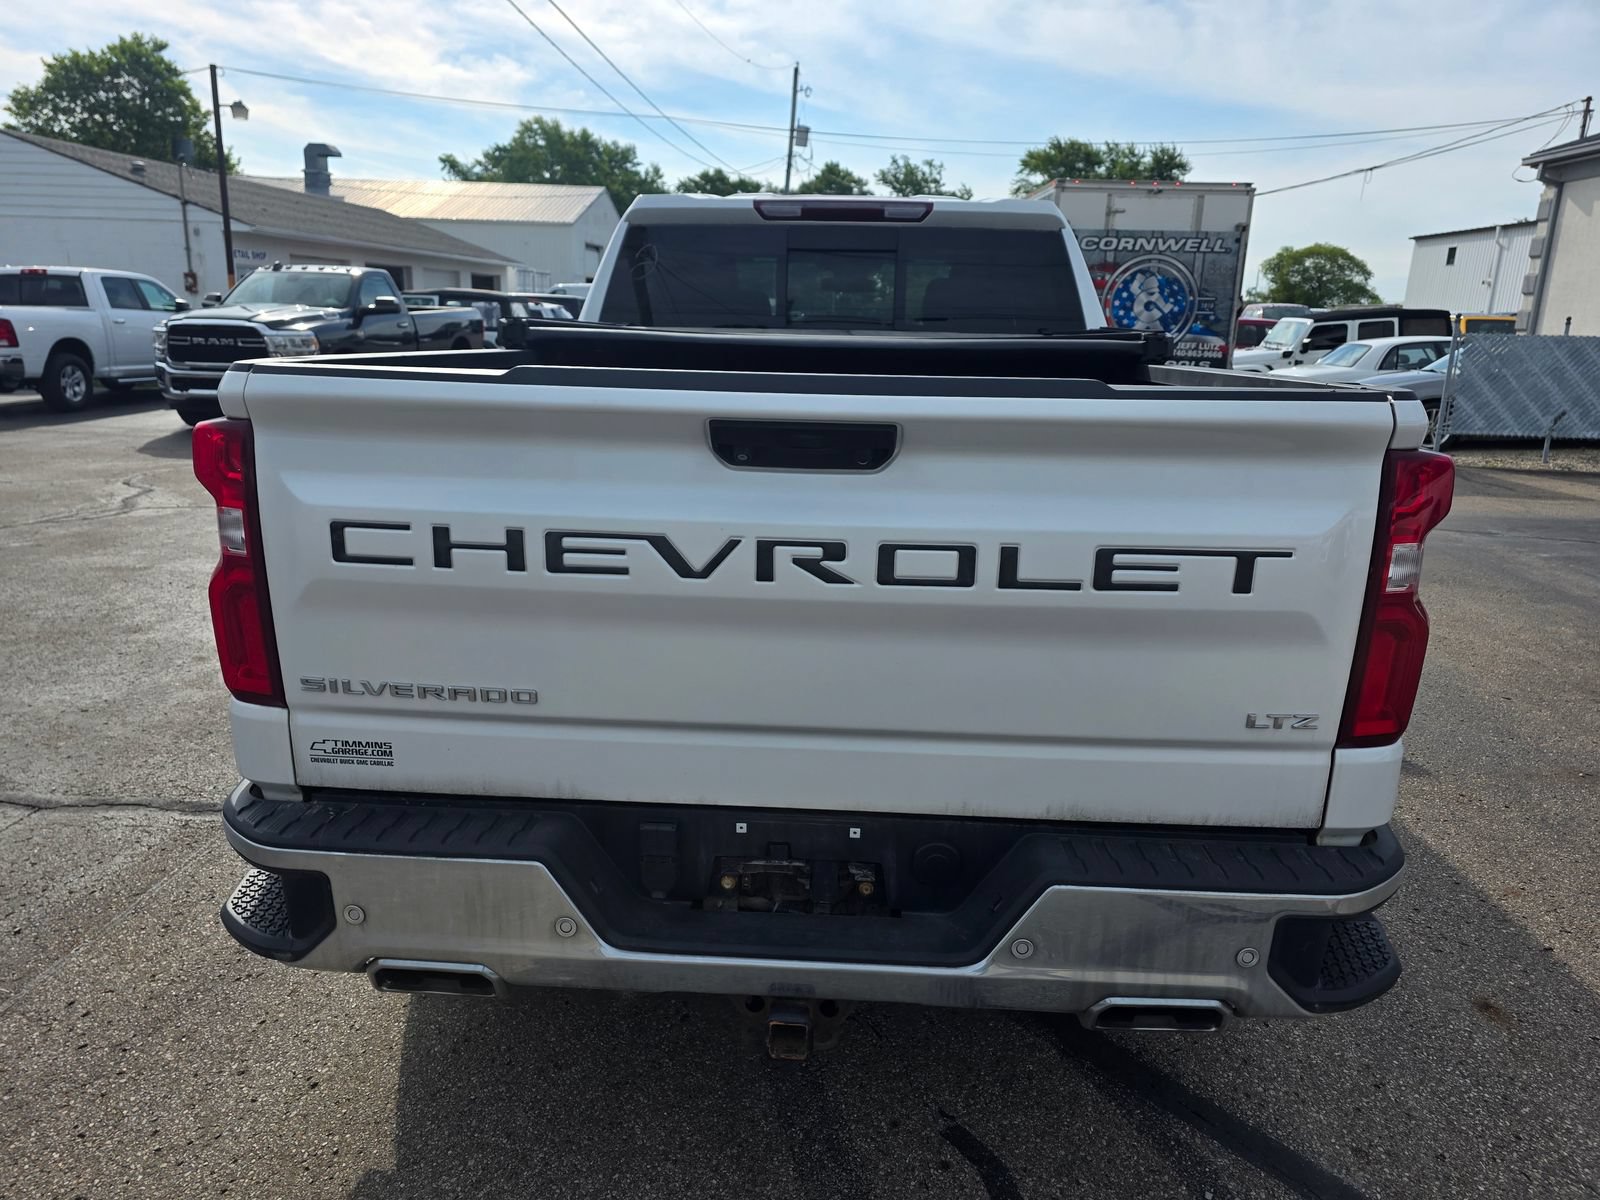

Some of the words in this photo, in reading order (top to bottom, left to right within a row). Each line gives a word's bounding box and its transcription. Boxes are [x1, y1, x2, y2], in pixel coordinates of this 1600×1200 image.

[1079, 236, 1226, 252] CORNWELL
[232, 249, 250, 259] ETAIL
[251, 251, 267, 260] SHOP
[191, 337, 235, 345] RAM
[1199, 343, 1220, 351] LUTZ
[1164, 360, 1211, 368] OOLS
[329, 519, 1294, 597] CHEVROLET
[300, 676, 538, 705] SILVERADO
[1245, 713, 1320, 730] LTZ
[330, 740, 393, 750] TIMMINS
[331, 747, 393, 757] GARAGE.COM
